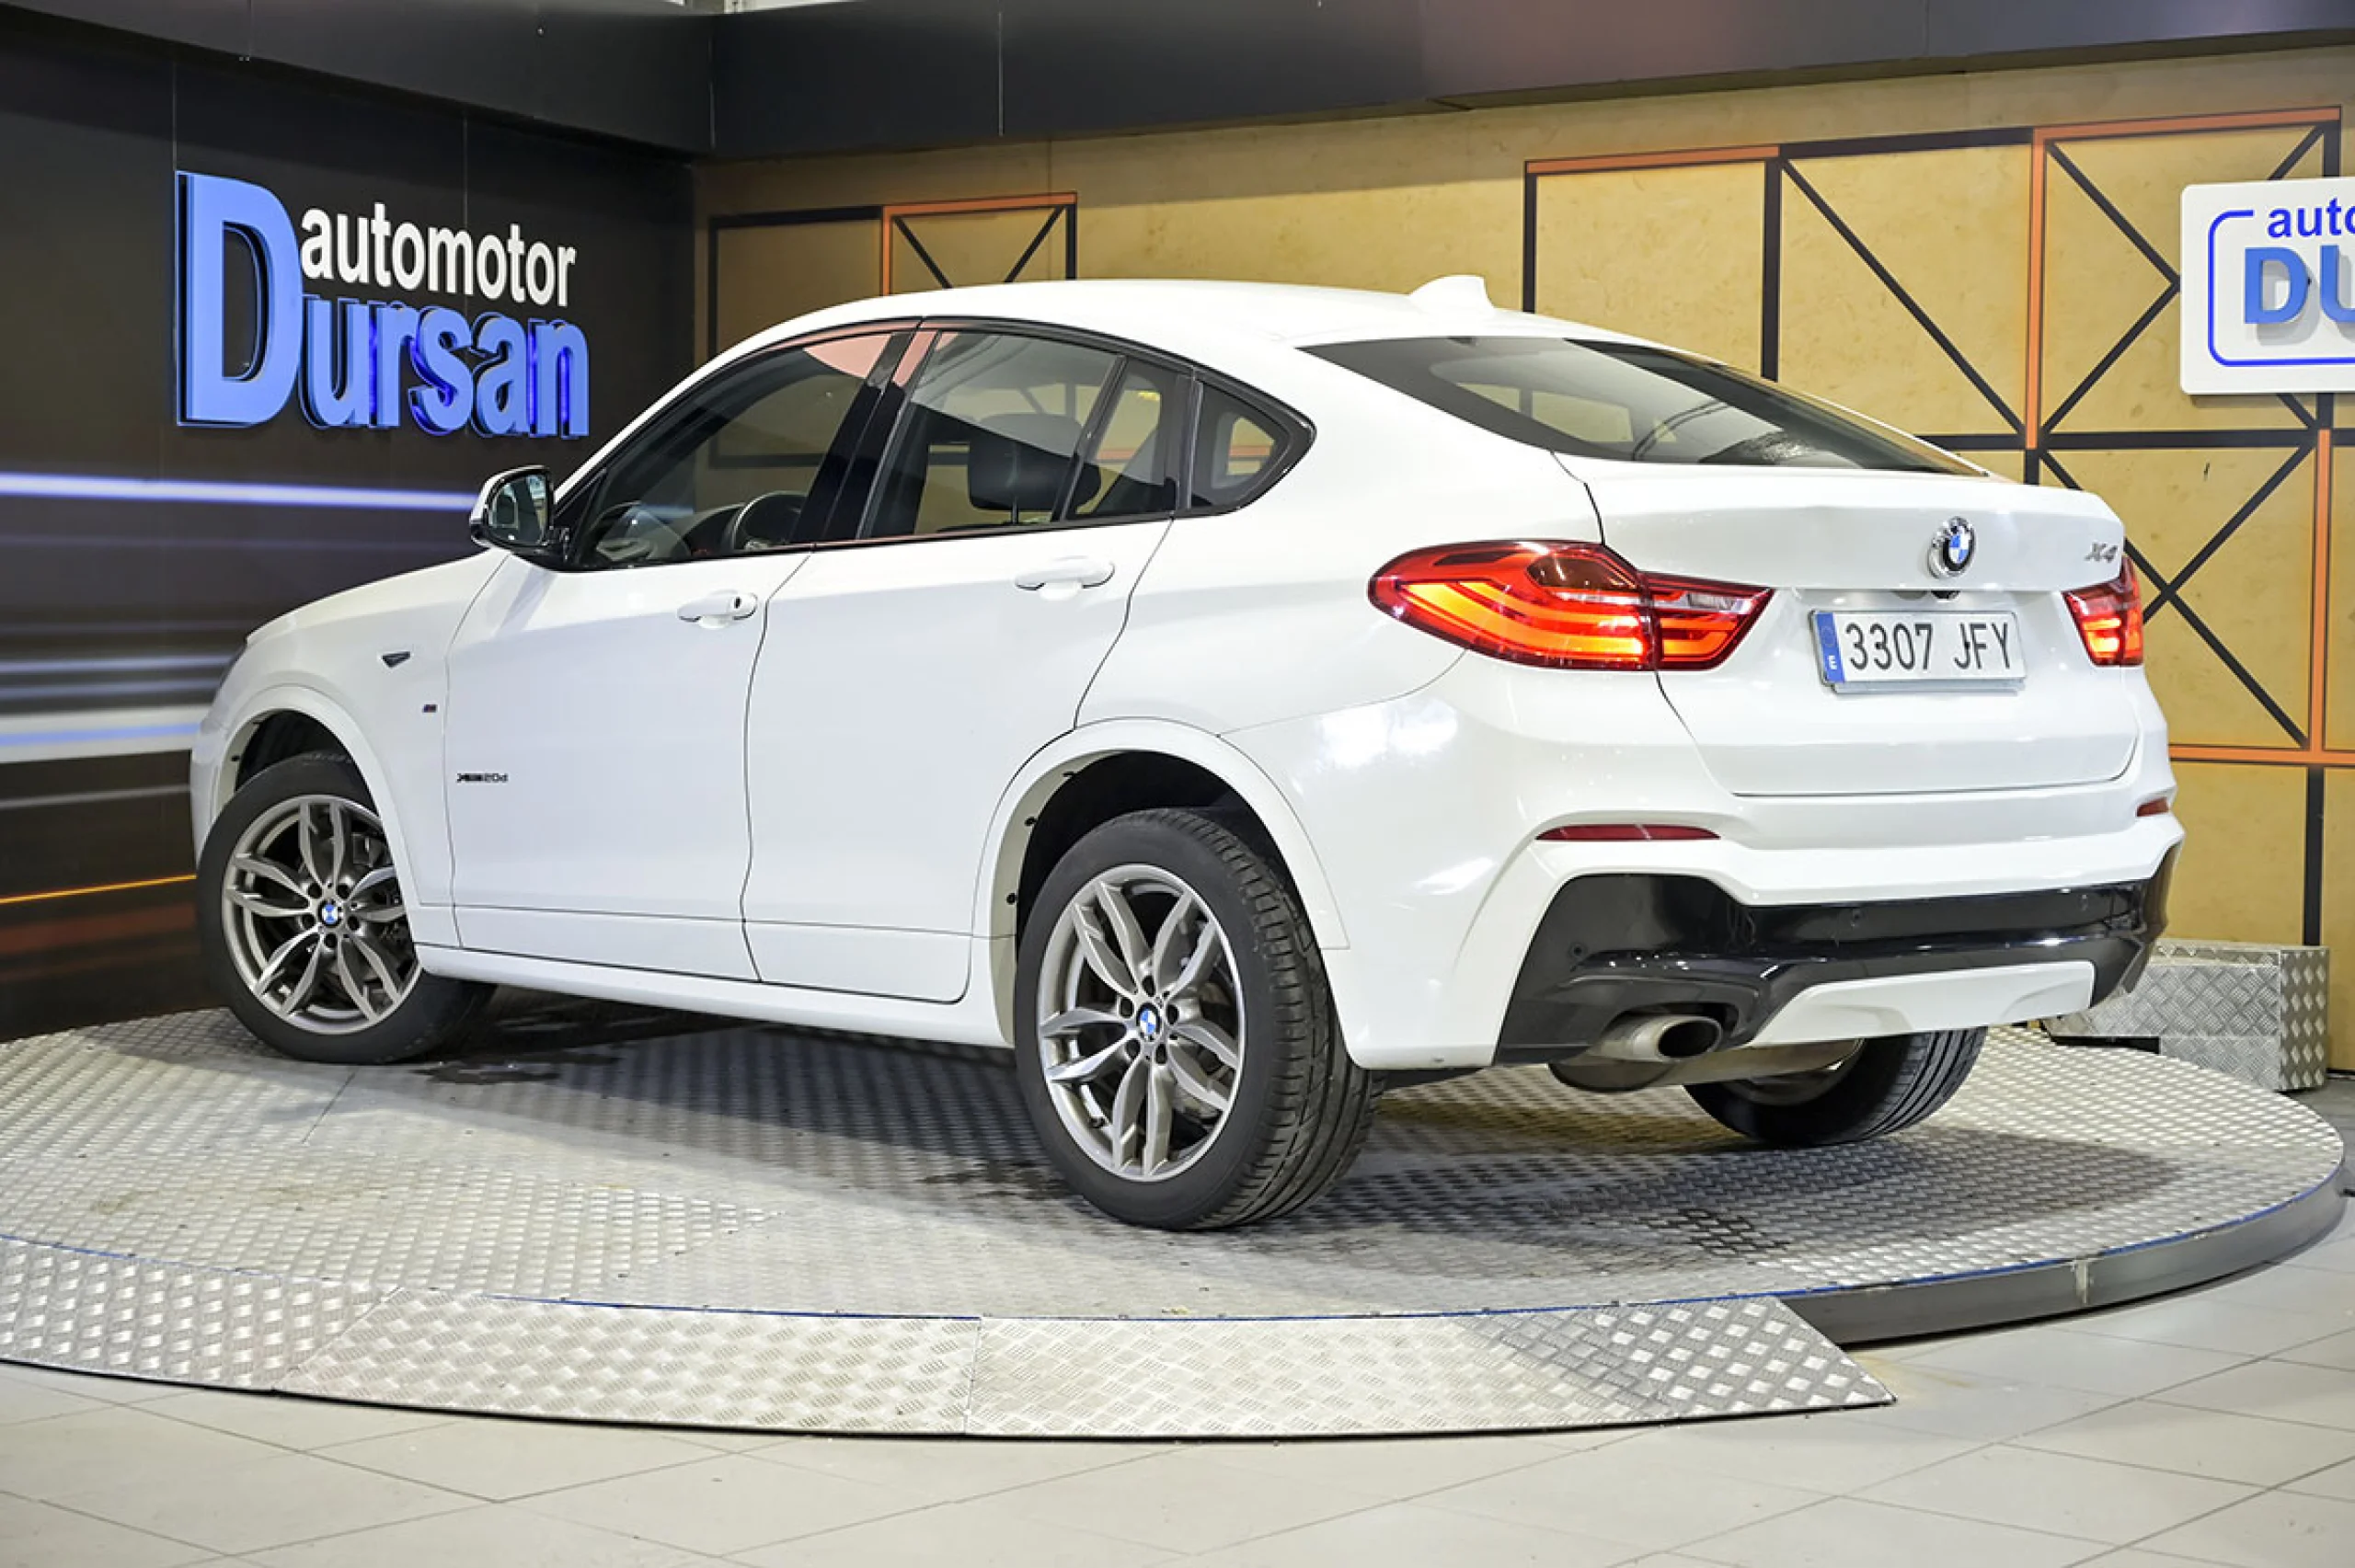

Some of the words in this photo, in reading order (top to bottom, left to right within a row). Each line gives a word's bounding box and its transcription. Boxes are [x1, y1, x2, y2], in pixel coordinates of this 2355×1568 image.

[176, 170, 590, 439] Dursan
[301, 201, 577, 307] automotor
[1845, 623, 1932, 670] 3307
[1954, 623, 2010, 670] JFY
